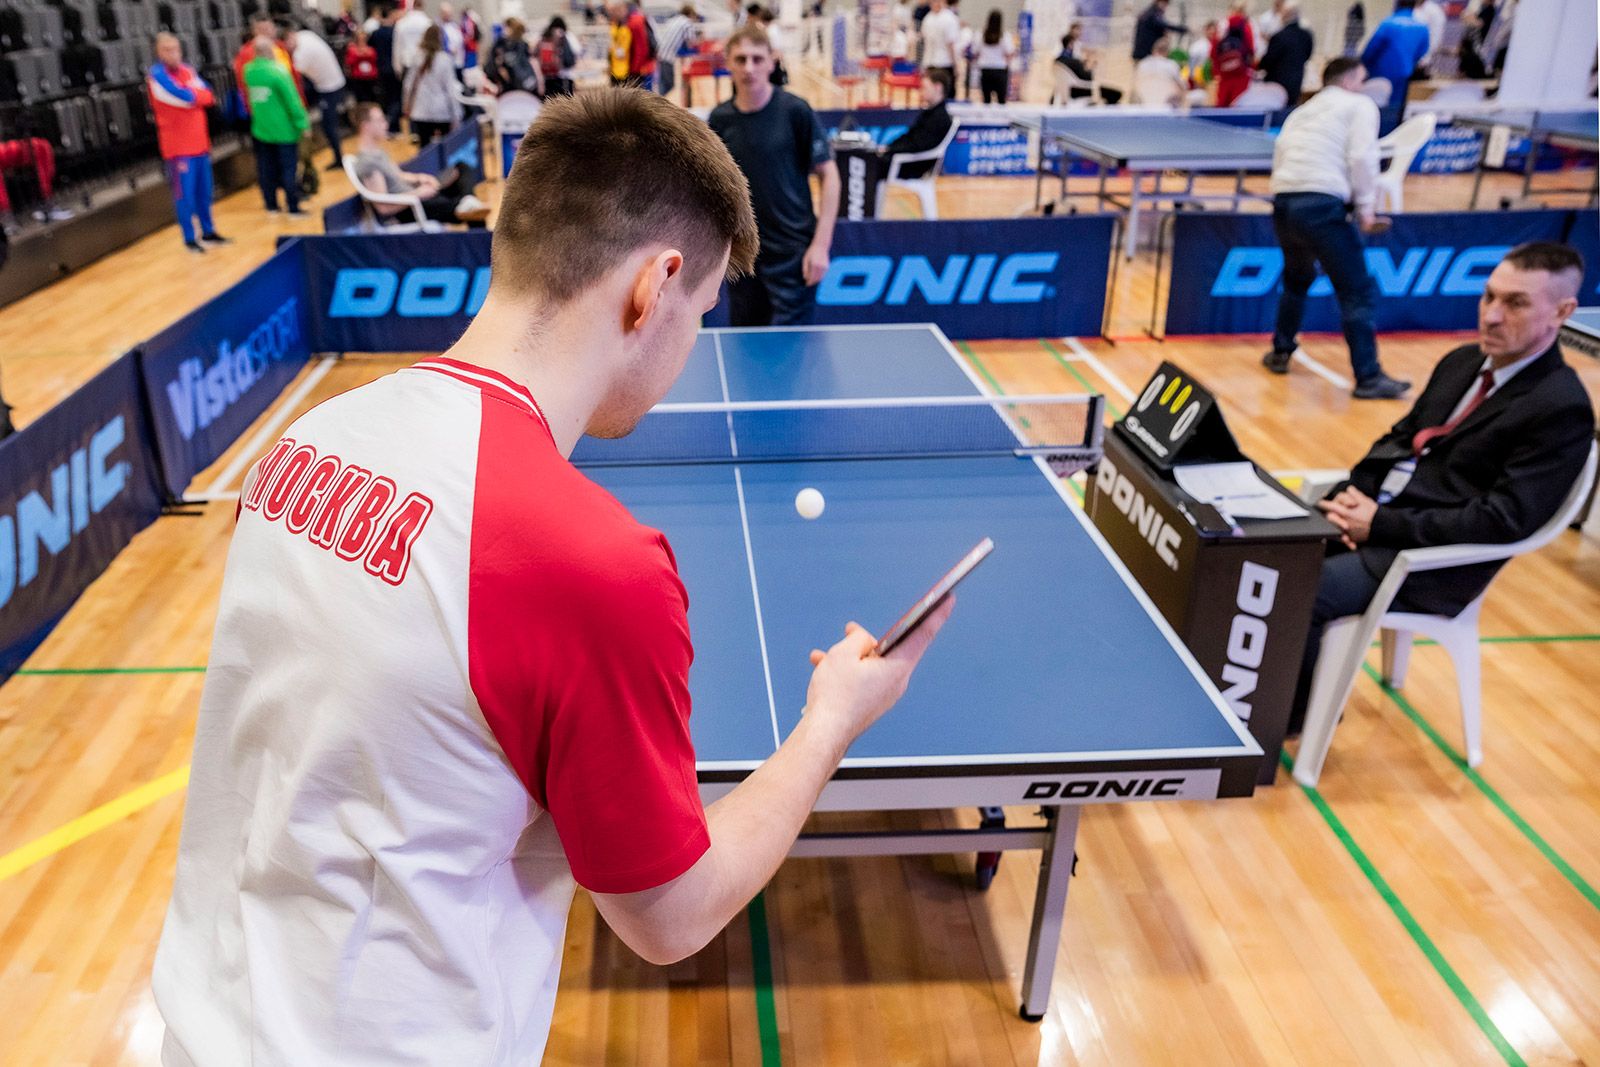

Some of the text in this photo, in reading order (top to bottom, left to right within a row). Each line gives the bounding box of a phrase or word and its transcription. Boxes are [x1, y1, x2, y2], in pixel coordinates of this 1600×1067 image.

[848, 156, 866, 222] DONI
[815, 252, 1059, 306] ONIC
[1210, 246, 1512, 297] DNIC
[1096, 455, 1182, 568] DONIC
[1221, 560, 1279, 729] DON
[1022, 778, 1186, 799] DONIC
